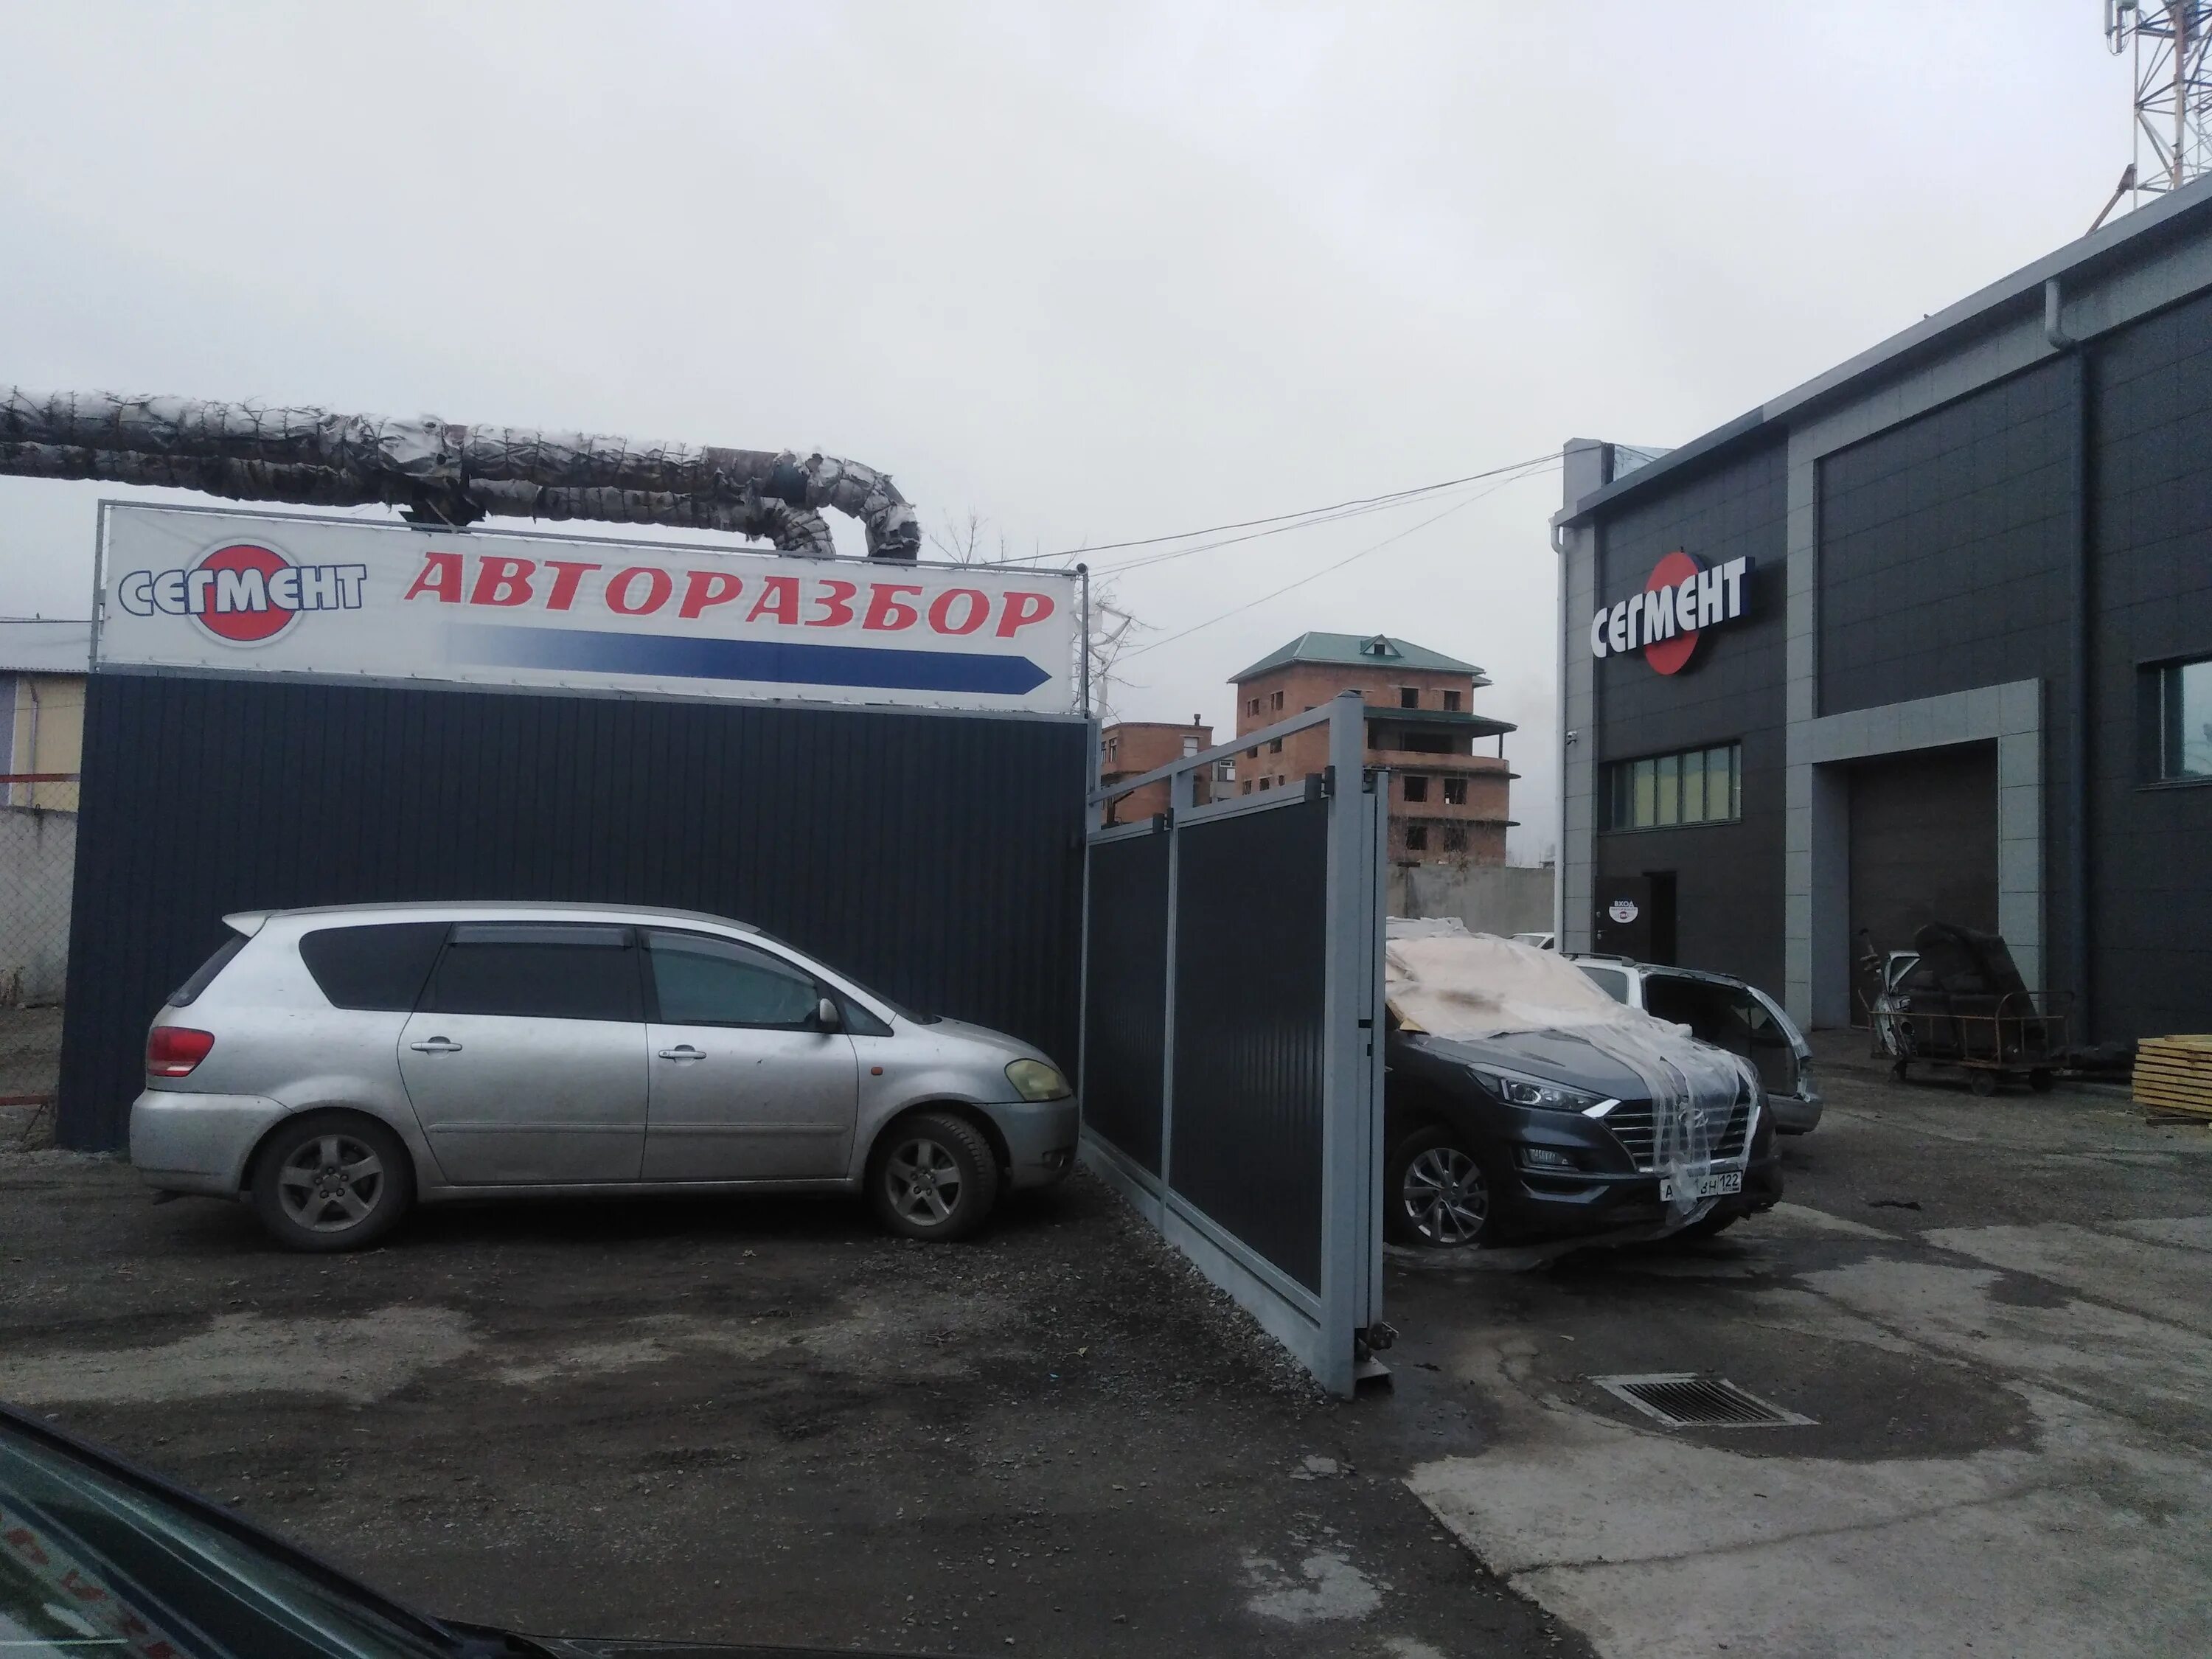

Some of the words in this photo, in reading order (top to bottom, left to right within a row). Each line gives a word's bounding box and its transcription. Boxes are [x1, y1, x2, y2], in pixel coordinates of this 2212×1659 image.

[119, 564, 366, 616] СЕГМЕНТ
[404, 552, 1055, 639] АВТОРАЗБОР
[1590, 556, 1747, 658] СЕГМЕНТ
[1614, 900, 1635, 908] ВХОД
[1720, 1174, 1739, 1187] 122
